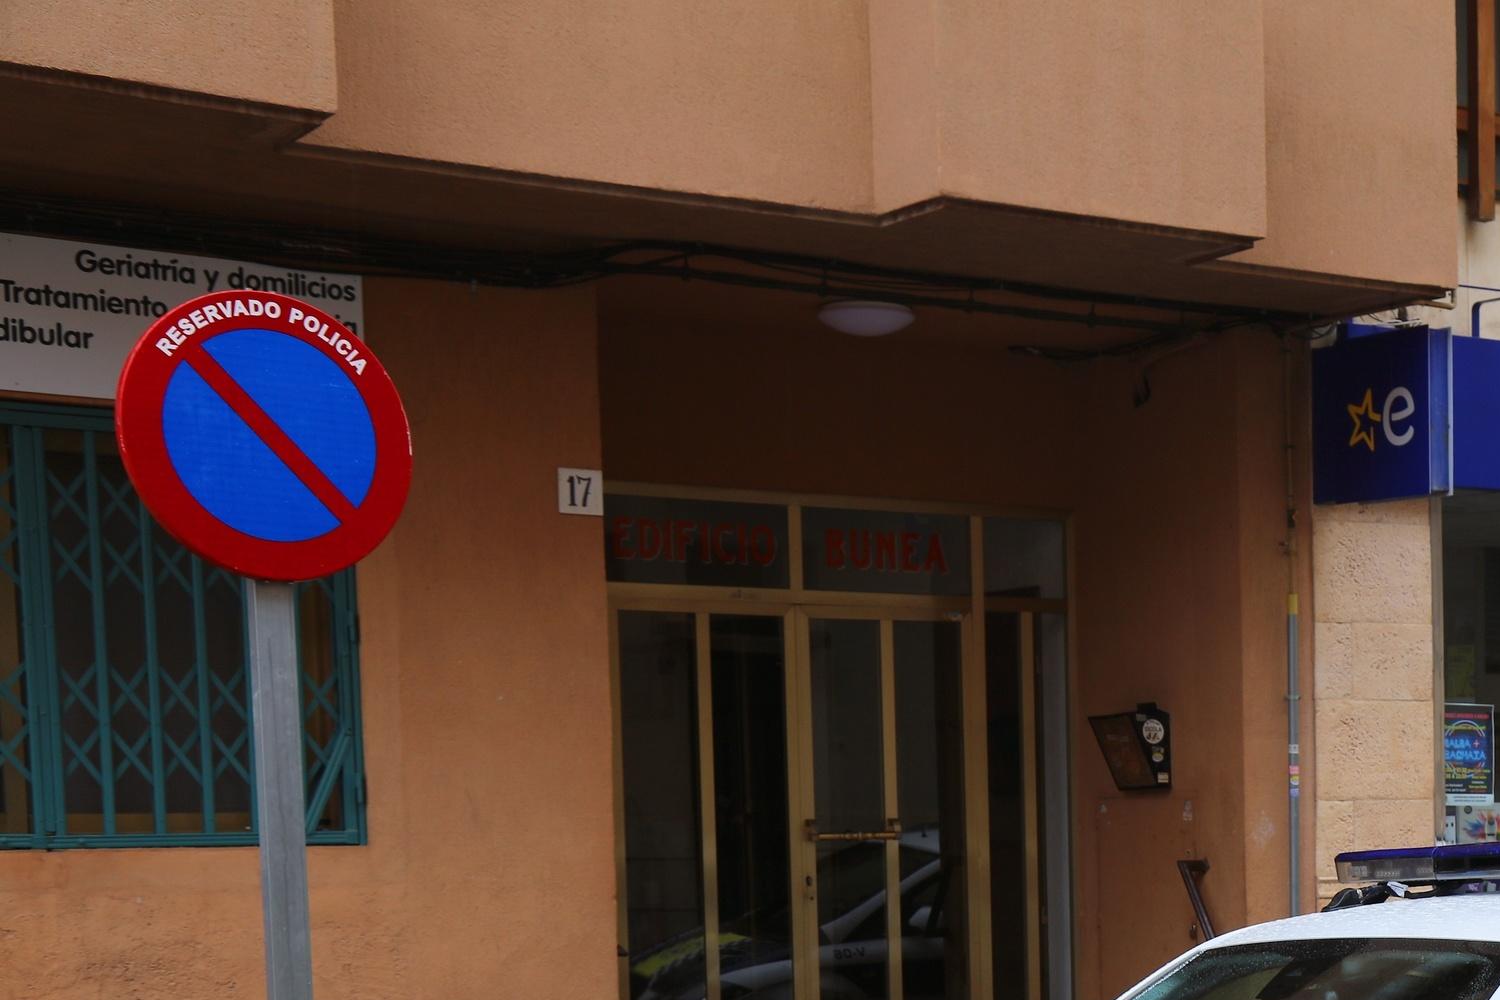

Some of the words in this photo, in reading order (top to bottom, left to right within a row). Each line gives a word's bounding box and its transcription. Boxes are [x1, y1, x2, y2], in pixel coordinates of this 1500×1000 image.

[0, 279, 169, 318] Tratamiento
[75, 249, 196, 285] Geriatría
[203, 269, 220, 291] y
[228, 266, 356, 301] domilicios
[155, 298, 282, 357] RESERVADO
[288, 307, 368, 376] POLICIA
[566, 475, 592, 509] 17
[611, 515, 777, 567] EDIFICIO
